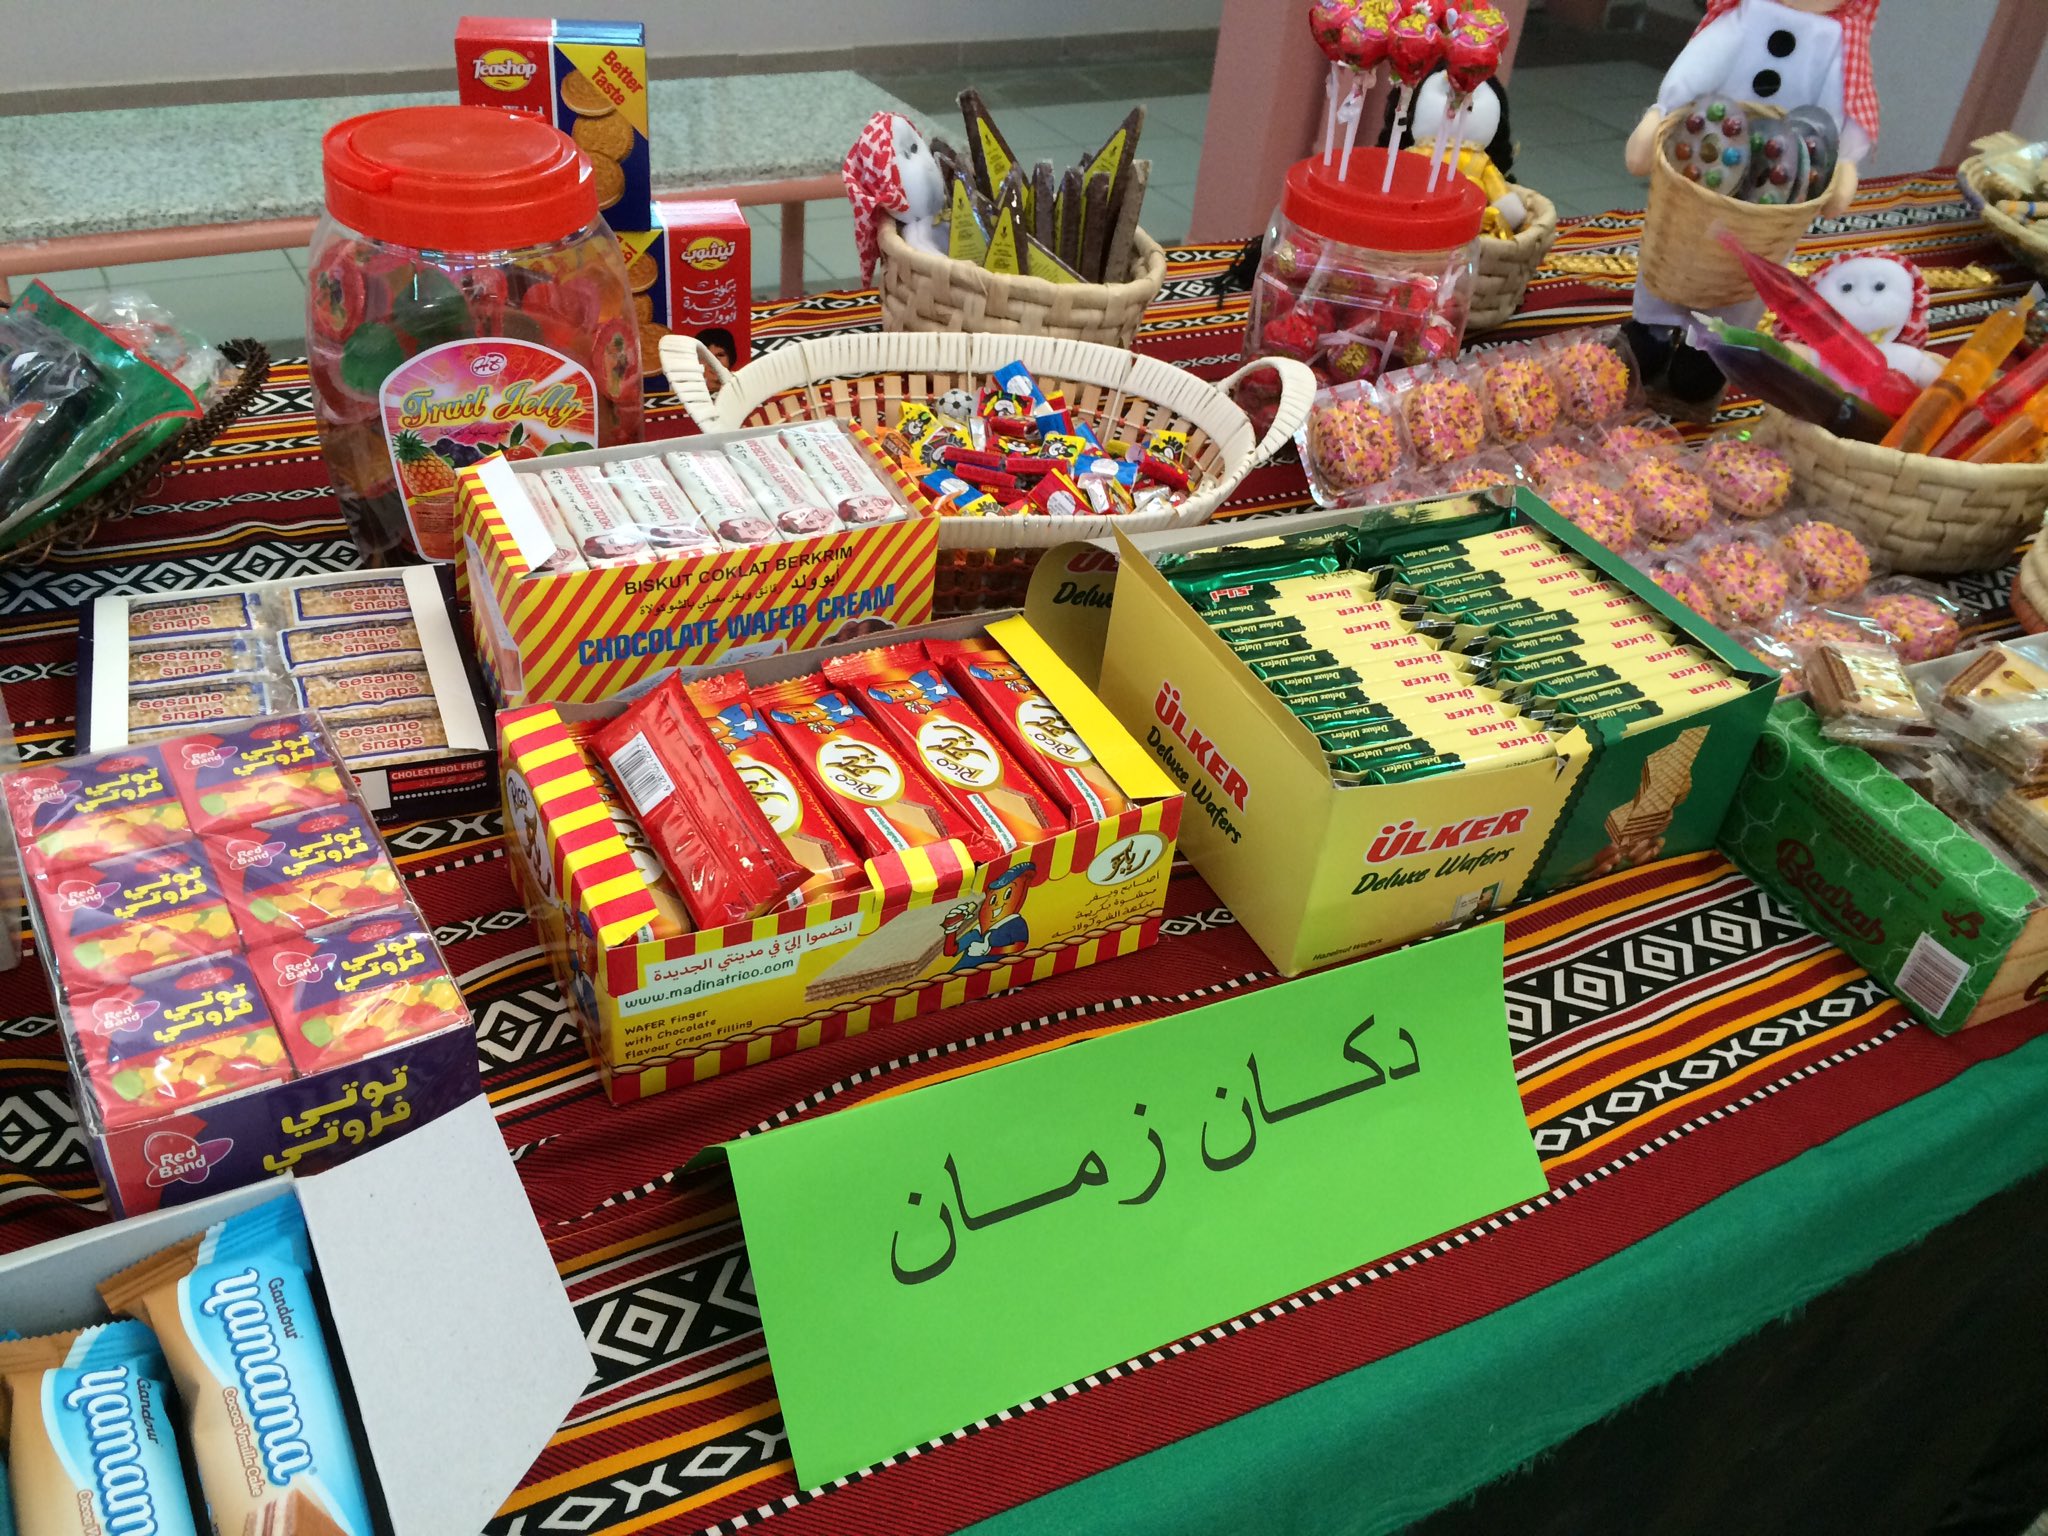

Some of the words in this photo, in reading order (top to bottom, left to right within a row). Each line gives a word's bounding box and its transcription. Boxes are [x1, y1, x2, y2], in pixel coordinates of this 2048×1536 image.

[473, 59, 537, 80] Teashop
[602, 50, 643, 93] Better
[591, 66, 626, 105] Taste
[681, 242, 736, 262] تيشوب
[402, 385, 489, 428] Fruit
[493, 380, 585, 429] Jelly
[1501, 543, 1541, 557] ÜLKER
[625, 573, 693, 596] BISKUT
[699, 560, 770, 584] COKLAT
[776, 545, 853, 572] BERKRIM
[1538, 570, 1579, 585] ÜLKER
[1306, 589, 1351, 601] ÜLKER
[353, 599, 409, 611] snaps
[1336, 602, 1383, 616] ÜLKER
[151, 615, 211, 631] snaps
[578, 618, 720, 667] CHOCOLATE
[726, 603, 807, 640] WAFER
[816, 583, 895, 623] CREAM
[1343, 620, 1391, 634] ÜLKER
[322, 627, 397, 643] sesame
[1370, 636, 1418, 650] ÜLKER
[1611, 633, 1656, 649] ÜLKER
[343, 639, 401, 653] snaps
[141, 650, 223, 662] sesame
[1394, 653, 1443, 667] ÜLKER
[1645, 647, 1688, 663] ÜLKER
[162, 663, 223, 676] snaps
[1668, 662, 1714, 679] ÜLKER
[338, 672, 416, 689] sesame
[1401, 672, 1451, 687] ÜLKER
[1688, 679, 1732, 695] ÜLKER
[361, 685, 420, 699] snaps
[1424, 688, 1475, 704] ÜLKER
[138, 693, 223, 709] sesame
[161, 707, 224, 722] snaps
[1444, 703, 1495, 720] ÜLKER
[338, 720, 420, 739] sesame
[1467, 719, 1517, 736] ÜLKER
[362, 735, 423, 751] snaps
[1155, 681, 1249, 813] ÜLKER
[1497, 733, 1549, 749] ÜLKER
[191, 750, 215, 761] Red
[191, 754, 222, 766] Band
[392, 765, 459, 780] CHOLESTEROL
[461, 760, 484, 771] FREE
[33, 783, 58, 796] Red
[1146, 725, 1189, 784] Deluxe
[1191, 778, 1241, 844] Wafers
[32, 789, 65, 801] Band
[1366, 809, 1529, 863] ÜLKER
[237, 846, 262, 858] Red
[237, 850, 269, 865] Band
[1351, 868, 1430, 895] Deluxe
[1435, 847, 1515, 878] Wafers
[68, 892, 101, 906] Band
[69, 887, 95, 899] Red
[806, 921, 852, 946] انضموا
[768, 939, 781, 956] في
[285, 959, 312, 973] Red
[717, 948, 764, 971] مدينتي
[285, 964, 319, 981] Band
[654, 958, 712, 982] الجديدة
[625, 958, 794, 1009] www.madinatrico.com
[103, 1012, 140, 1029] Band
[104, 1006, 132, 1020] Red
[624, 1020, 666, 1035] WAFER
[671, 1008, 708, 1025] Finger
[625, 1035, 653, 1048] with
[657, 1019, 716, 1039] Chocolate
[625, 1043, 671, 1061] Flavour
[675, 1031, 712, 1046] Cream
[717, 1020, 753, 1035] Filling
[1200, 1014, 1421, 1173] دكان
[160, 1145, 197, 1167] Red
[158, 1155, 207, 1178] Band
[890, 1102, 1168, 1286] زمان
[268, 1277, 298, 1340] Gandour
[136, 1378, 159, 1445] Gandour
[222, 1386, 243, 1426] Cocoa
[233, 1424, 258, 1469] Vanilla
[244, 1466, 263, 1498] Cake
[77, 1490, 95, 1525] Cocoa
